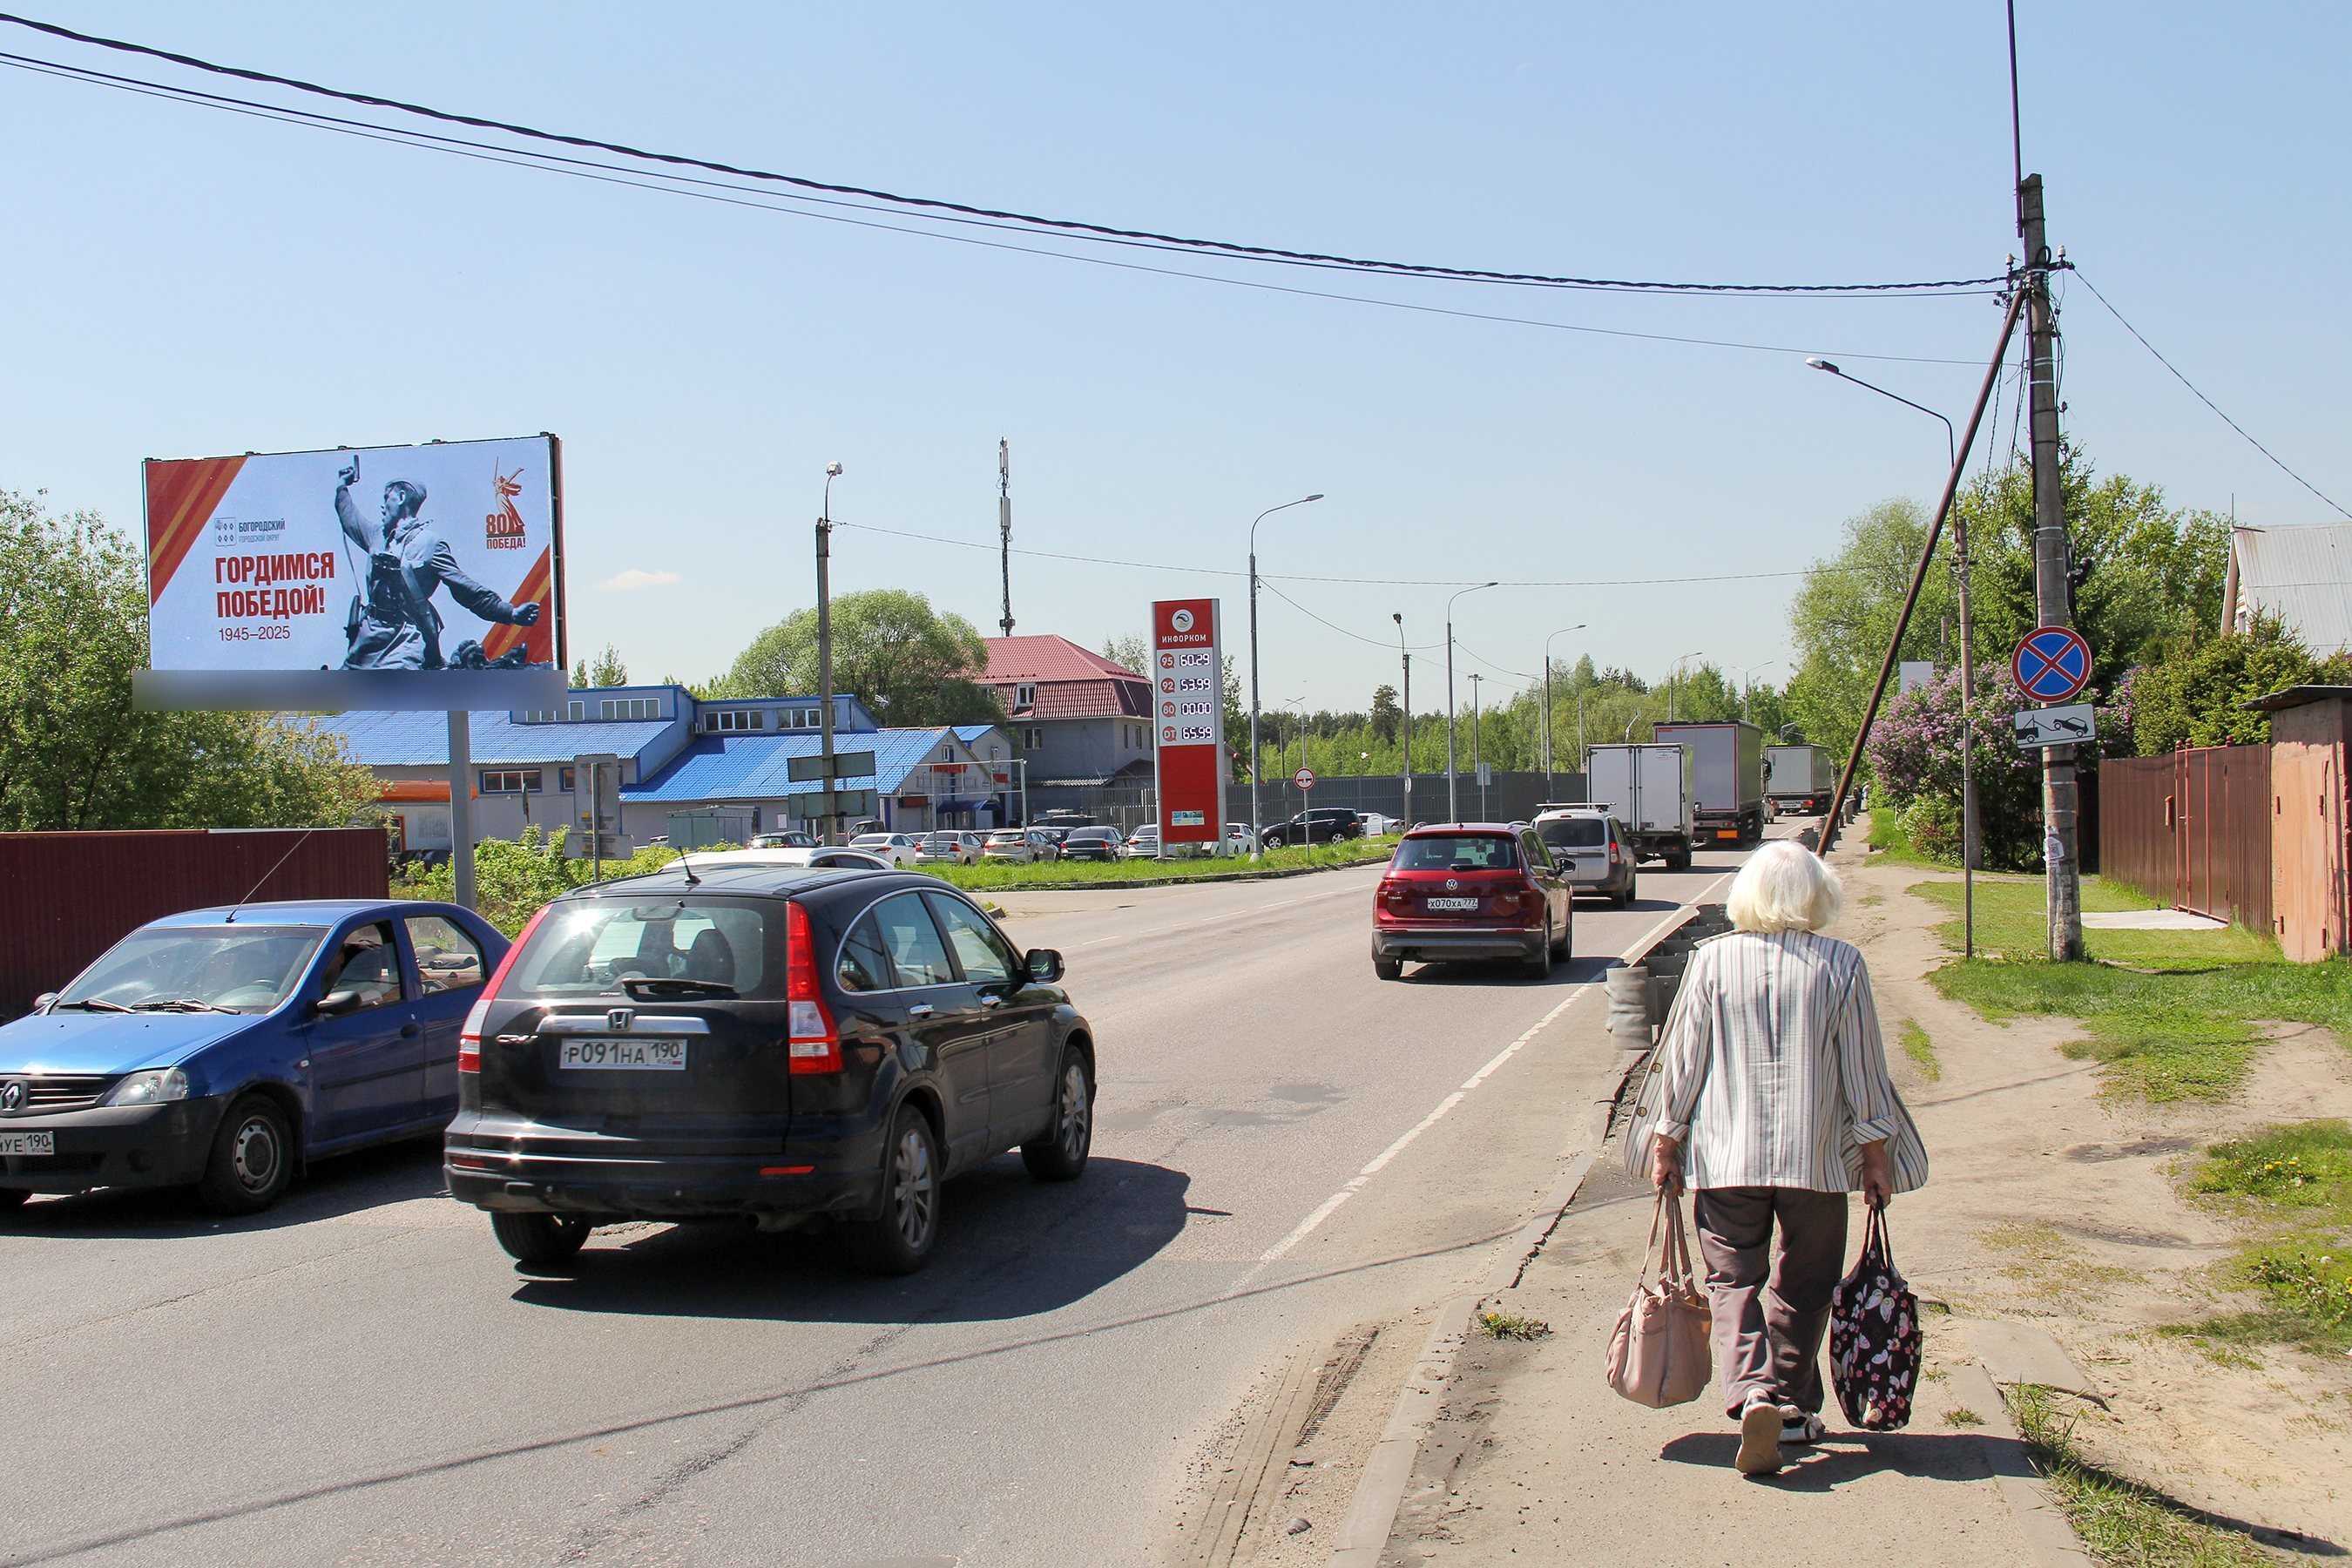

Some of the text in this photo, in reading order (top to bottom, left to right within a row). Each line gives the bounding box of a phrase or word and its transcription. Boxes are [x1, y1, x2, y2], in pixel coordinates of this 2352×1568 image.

[239, 518, 286, 532] БОГОРОДСКИЙ
[239, 533, 280, 543] ГОРОДСКОЙ ОКРУГ
[487, 537, 526, 550] ПОБЕДА!
[215, 552, 335, 586] ГОРДИМСЯ
[217, 585, 325, 620] ПОБЕДОЙ!
[1161, 634, 1206, 643] ИНФОРКОМ
[1161, 653, 1210, 666] 95 60.29
[1162, 678, 1211, 691] 92 53.99
[1163, 702, 1212, 715] 80 00.00
[1182, 727, 1213, 740] 65.99
[651, 1043, 679, 1058] 190
[0, 1134, 49, 1152] УЕ 190
